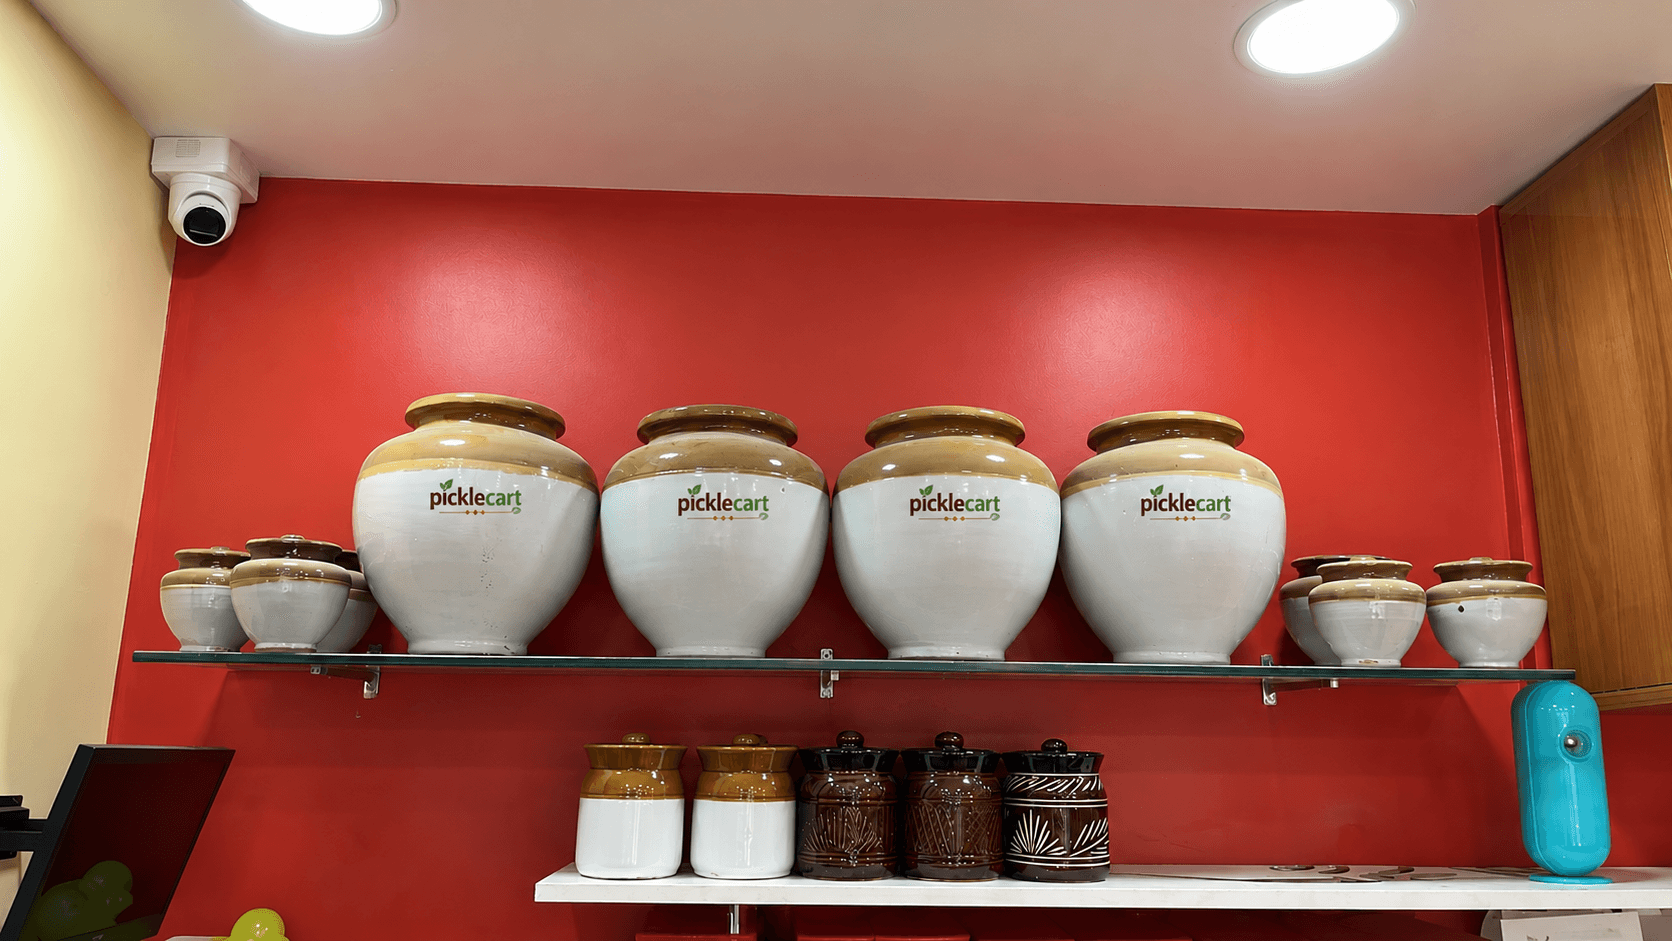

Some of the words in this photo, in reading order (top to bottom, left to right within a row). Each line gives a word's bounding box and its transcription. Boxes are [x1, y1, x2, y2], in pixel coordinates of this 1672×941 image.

[429, 486, 522, 511] picklecart
[677, 492, 770, 517] picklecart
[909, 492, 1001, 517] picklecart
[1140, 492, 1232, 517] picklecart
